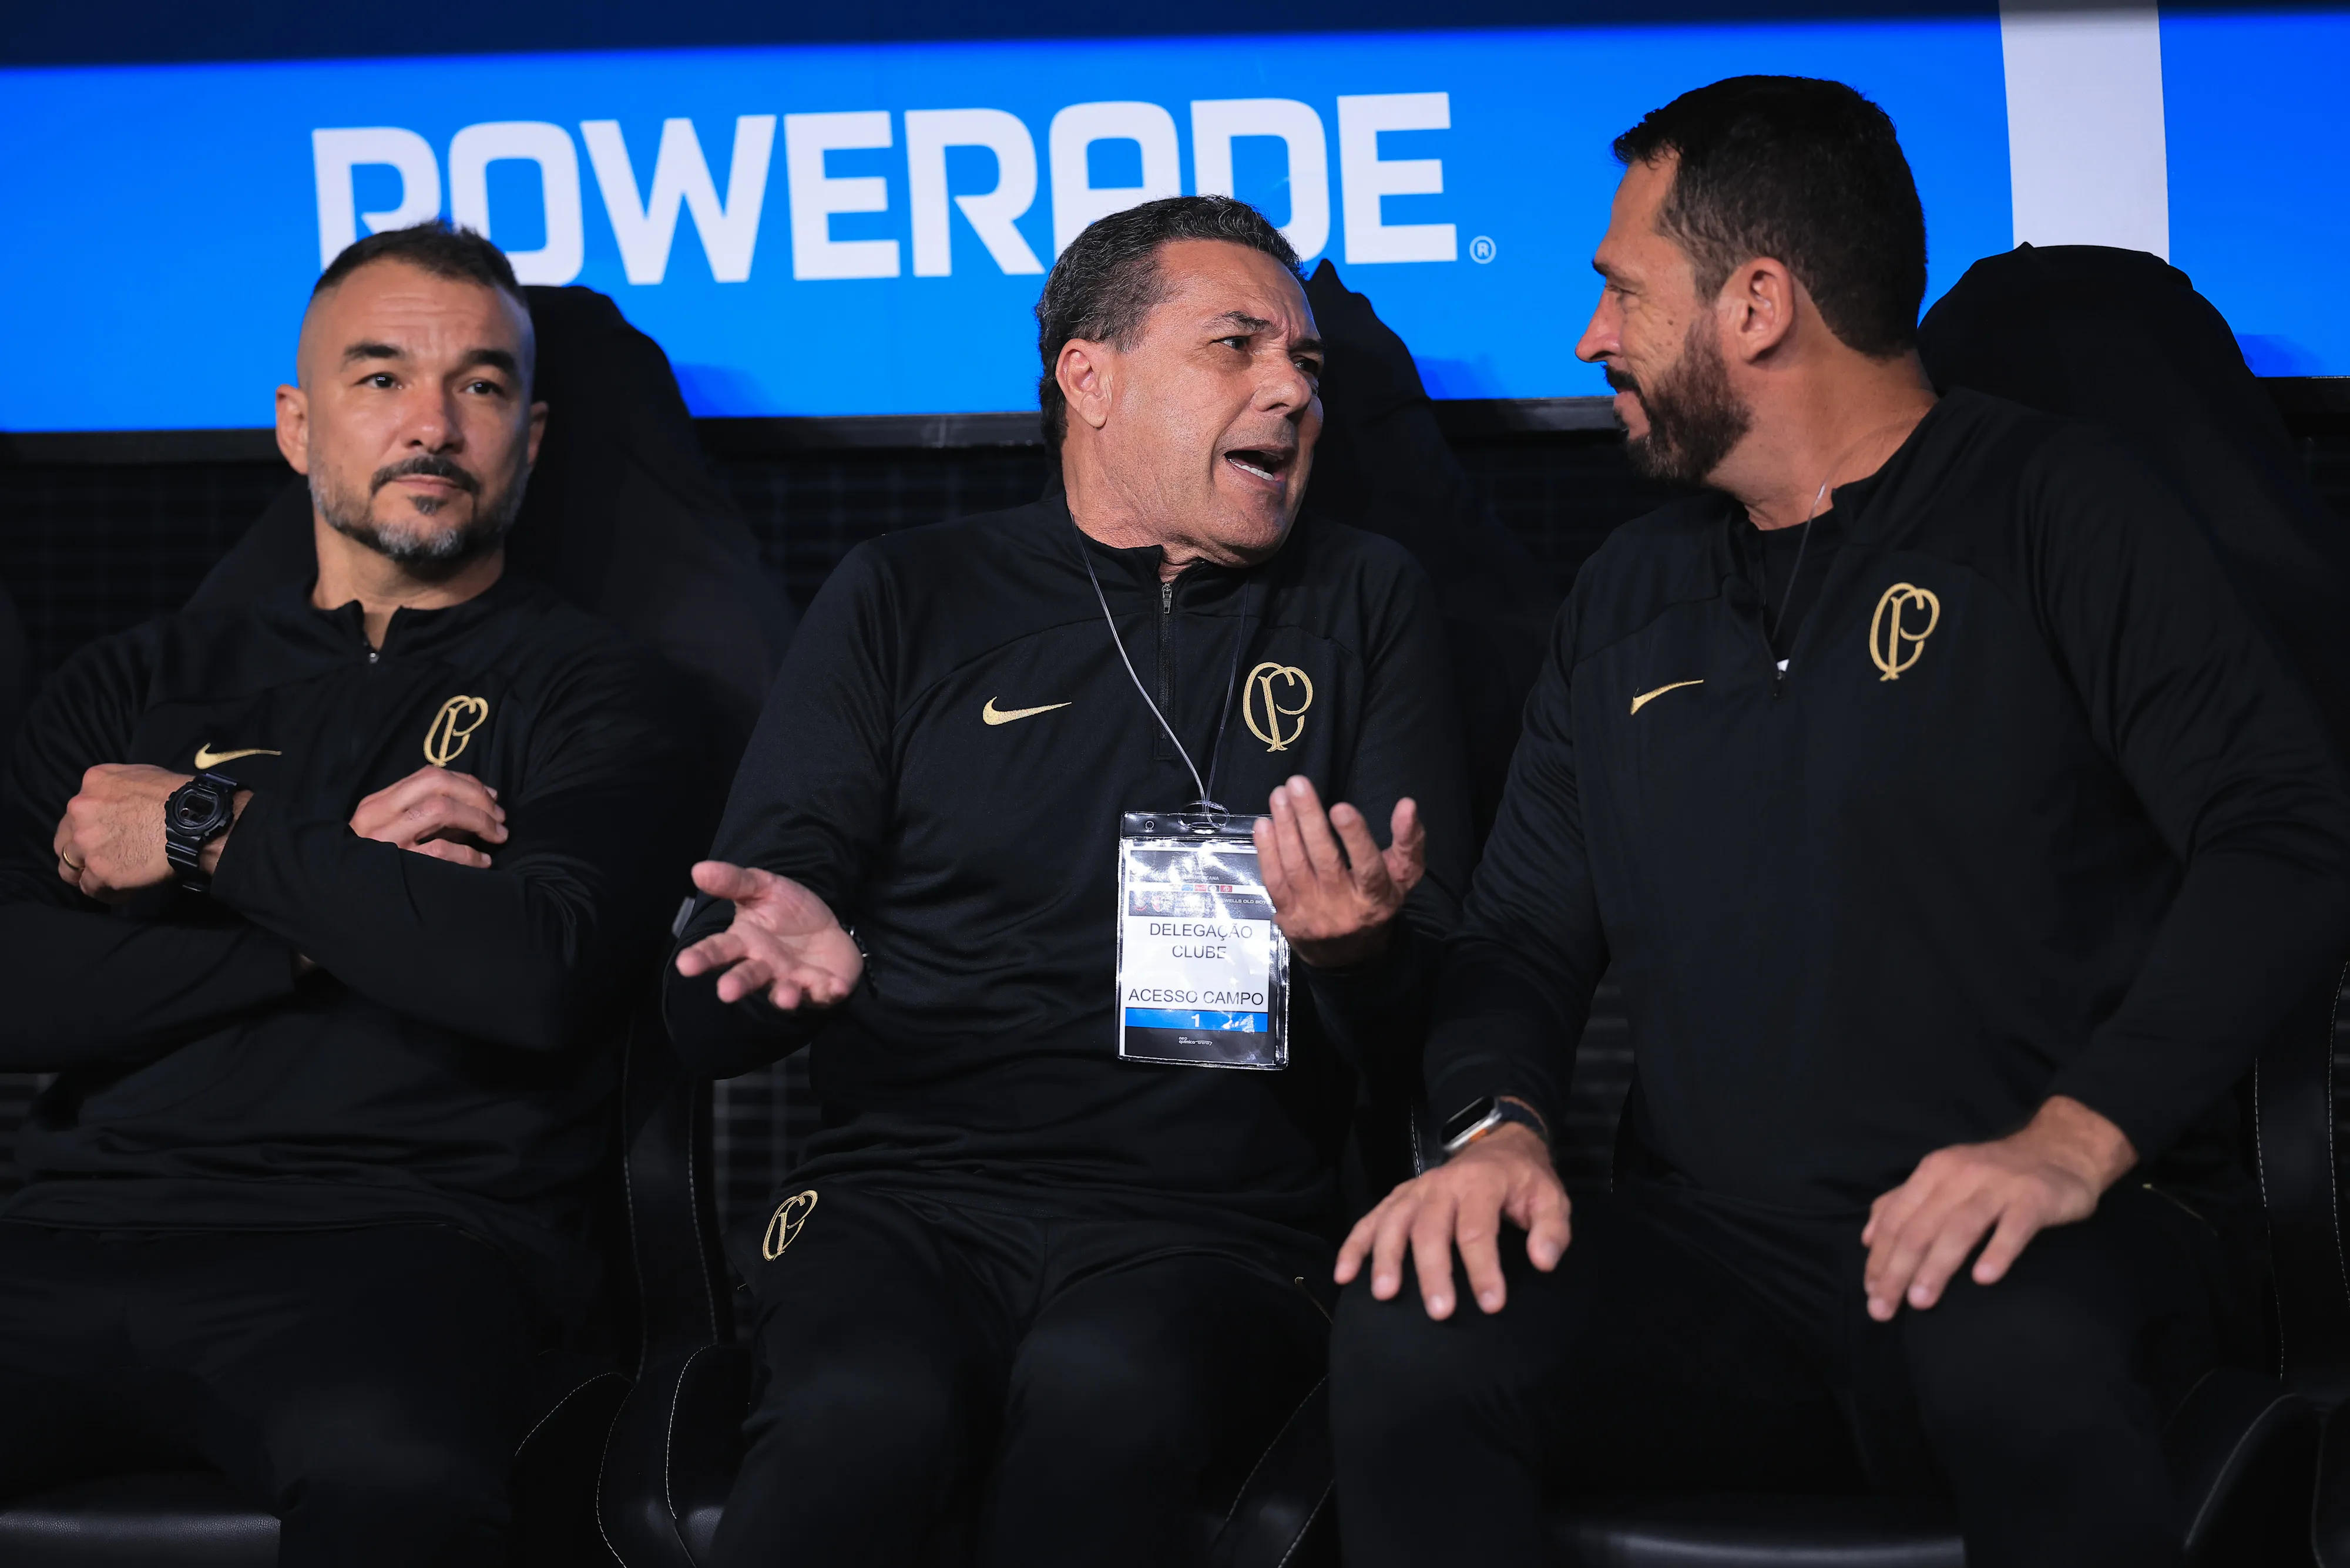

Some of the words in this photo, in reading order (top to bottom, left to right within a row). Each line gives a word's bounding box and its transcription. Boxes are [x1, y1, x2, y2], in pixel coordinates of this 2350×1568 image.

[313, 92, 1458, 287] POWERADE
[1150, 923, 1253, 941] DELEGAÇÃO
[1172, 945, 1227, 959] CLUBE
[1129, 989, 1198, 1003] ACESSO
[1203, 991, 1264, 1005] CAMPO
[1191, 1013, 1200, 1028] 1
